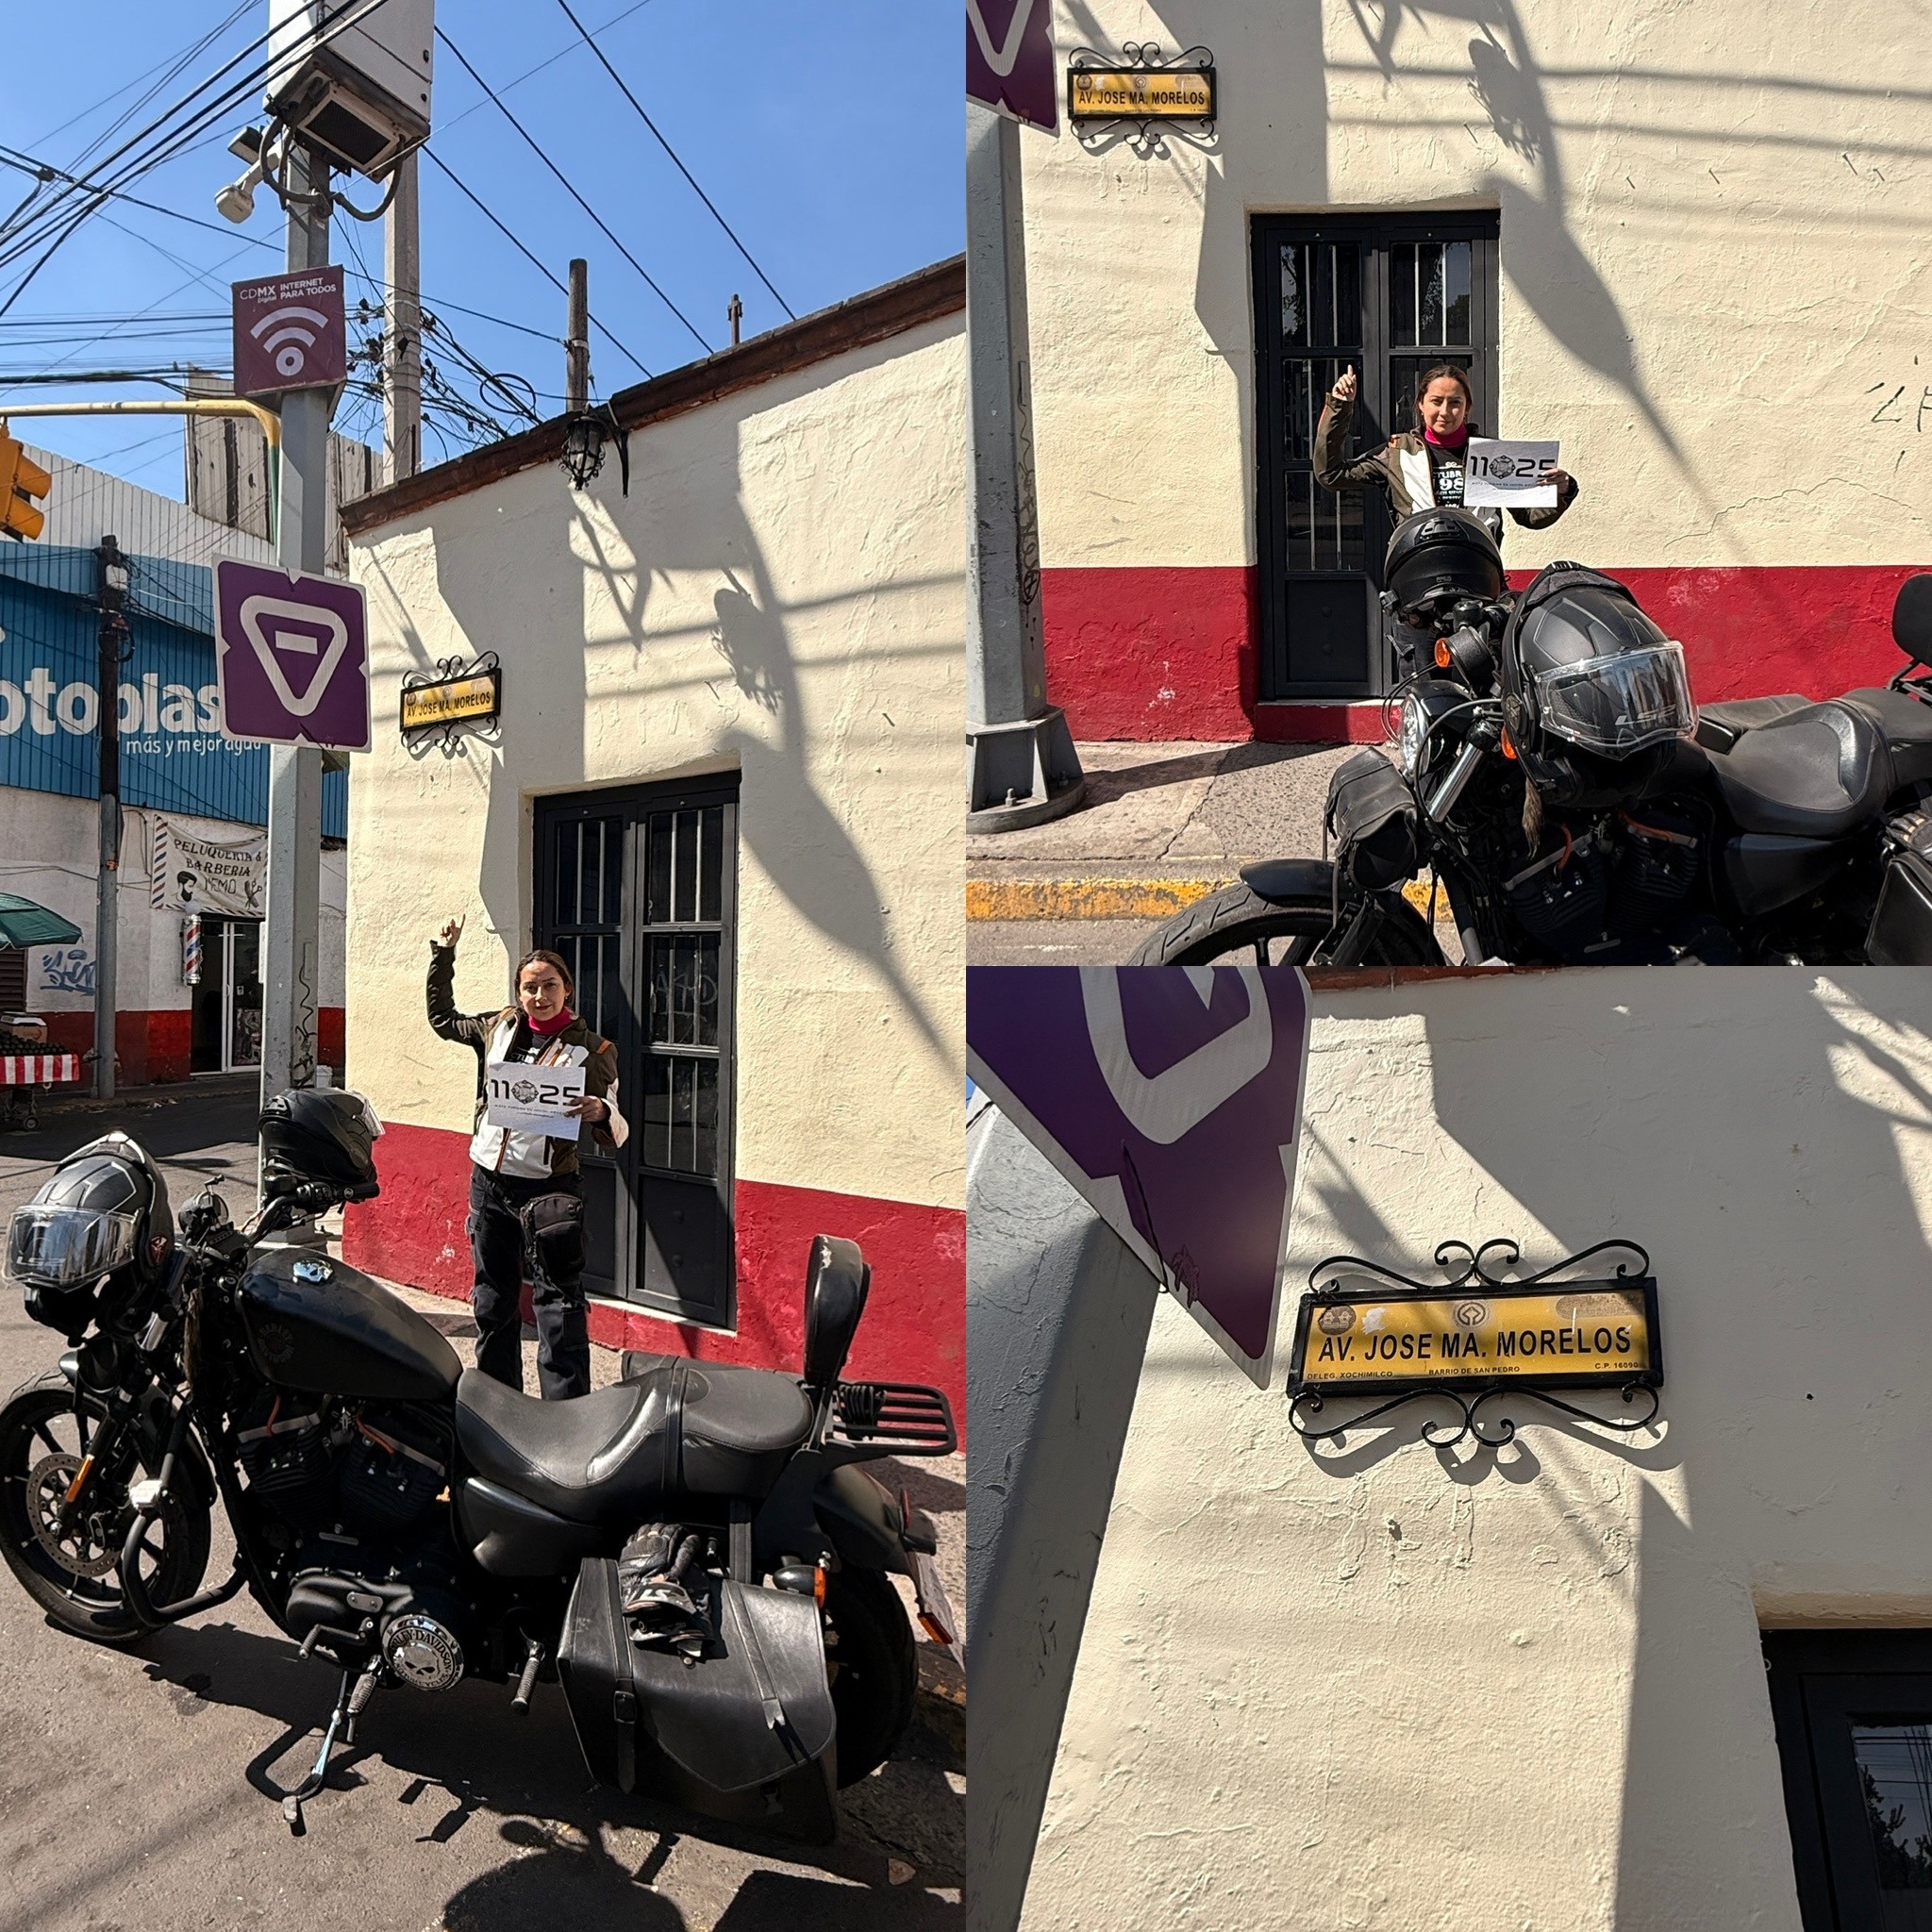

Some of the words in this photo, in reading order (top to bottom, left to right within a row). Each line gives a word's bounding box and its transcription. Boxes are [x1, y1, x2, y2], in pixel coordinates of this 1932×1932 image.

[1078, 92, 1094, 104] AV.
[1098, 91, 1125, 104] JOSE
[1129, 92, 1148, 104] MA.
[1152, 91, 1205, 105] MORELOS
[240, 285, 276, 300] CDMX
[280, 277, 324, 291] INTERNET
[280, 290, 304, 300] PARA
[306, 284, 337, 295] TODOS
[407, 706, 417, 718] AV.
[419, 702, 438, 716] JOSE
[453, 691, 491, 709] MORELOS
[126, 735, 161, 755] más
[165, 740, 174, 758] y
[177, 735, 223, 756] mejor
[225, 740, 261, 756] agua
[186, 857, 251, 877] BARBERIA
[1318, 1336, 1356, 1361] AV.
[1364, 1333, 1432, 1360] JOSE
[1441, 1332, 1487, 1357] MA.
[1496, 1326, 1631, 1357] MORELOS
[1307, 1372, 1338, 1380] DELEG.
[1340, 1371, 1393, 1379] XOCHIMILCO
